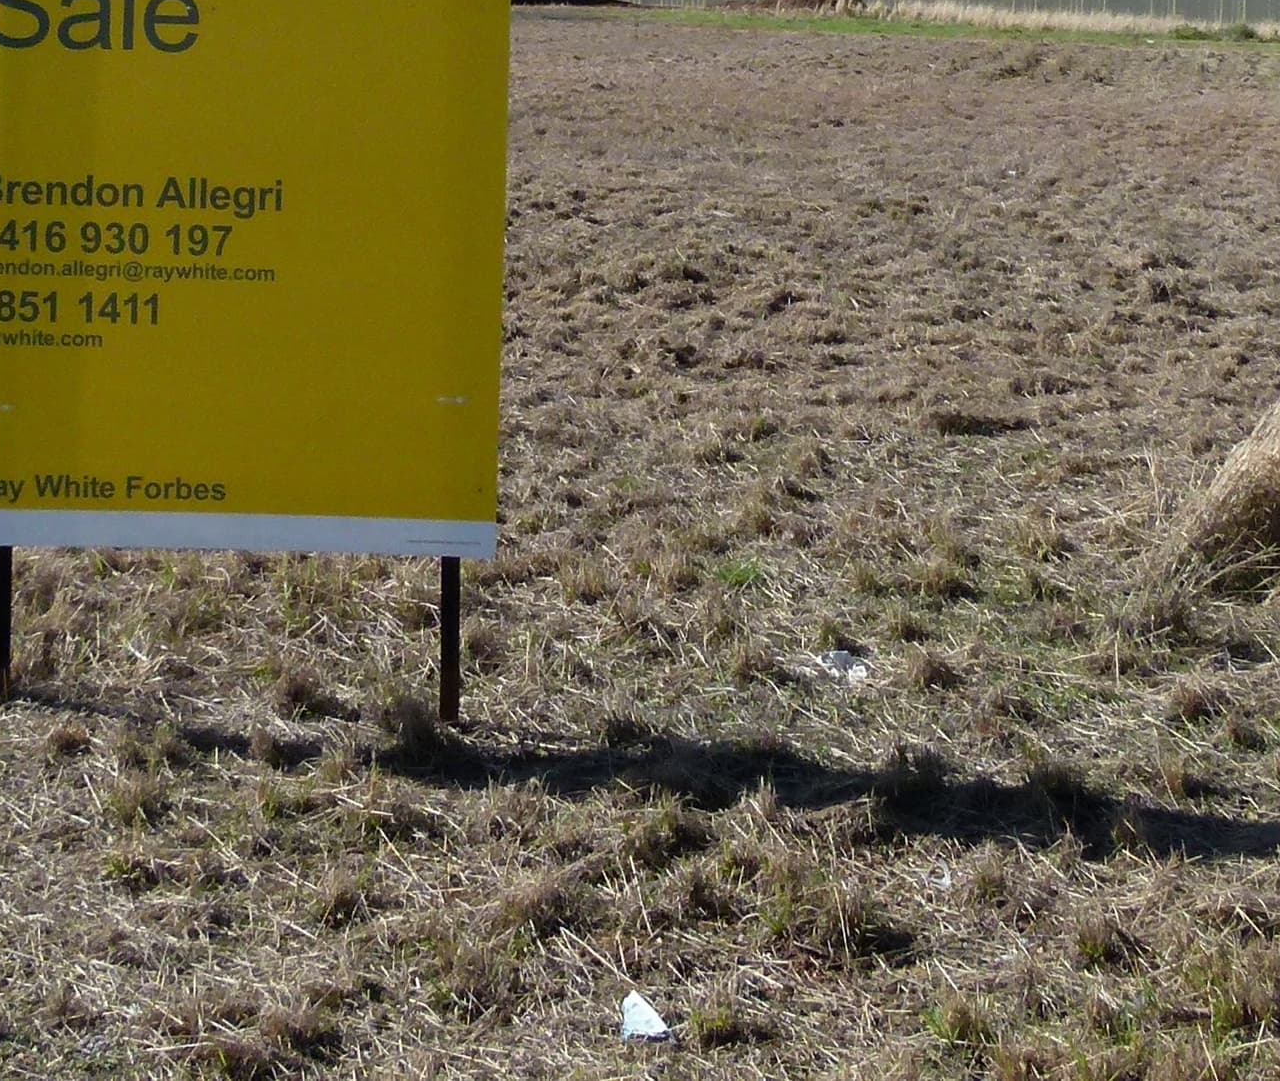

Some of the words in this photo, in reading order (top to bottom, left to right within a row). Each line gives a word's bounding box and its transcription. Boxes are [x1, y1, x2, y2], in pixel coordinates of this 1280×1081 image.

[156, 176, 283, 219] Allegri
[79, 221, 150, 256] 930
[165, 224, 233, 257] 197
[78, 291, 159, 326] 1411
[34, 474, 115, 499] White
[125, 475, 227, 502] Forbes
